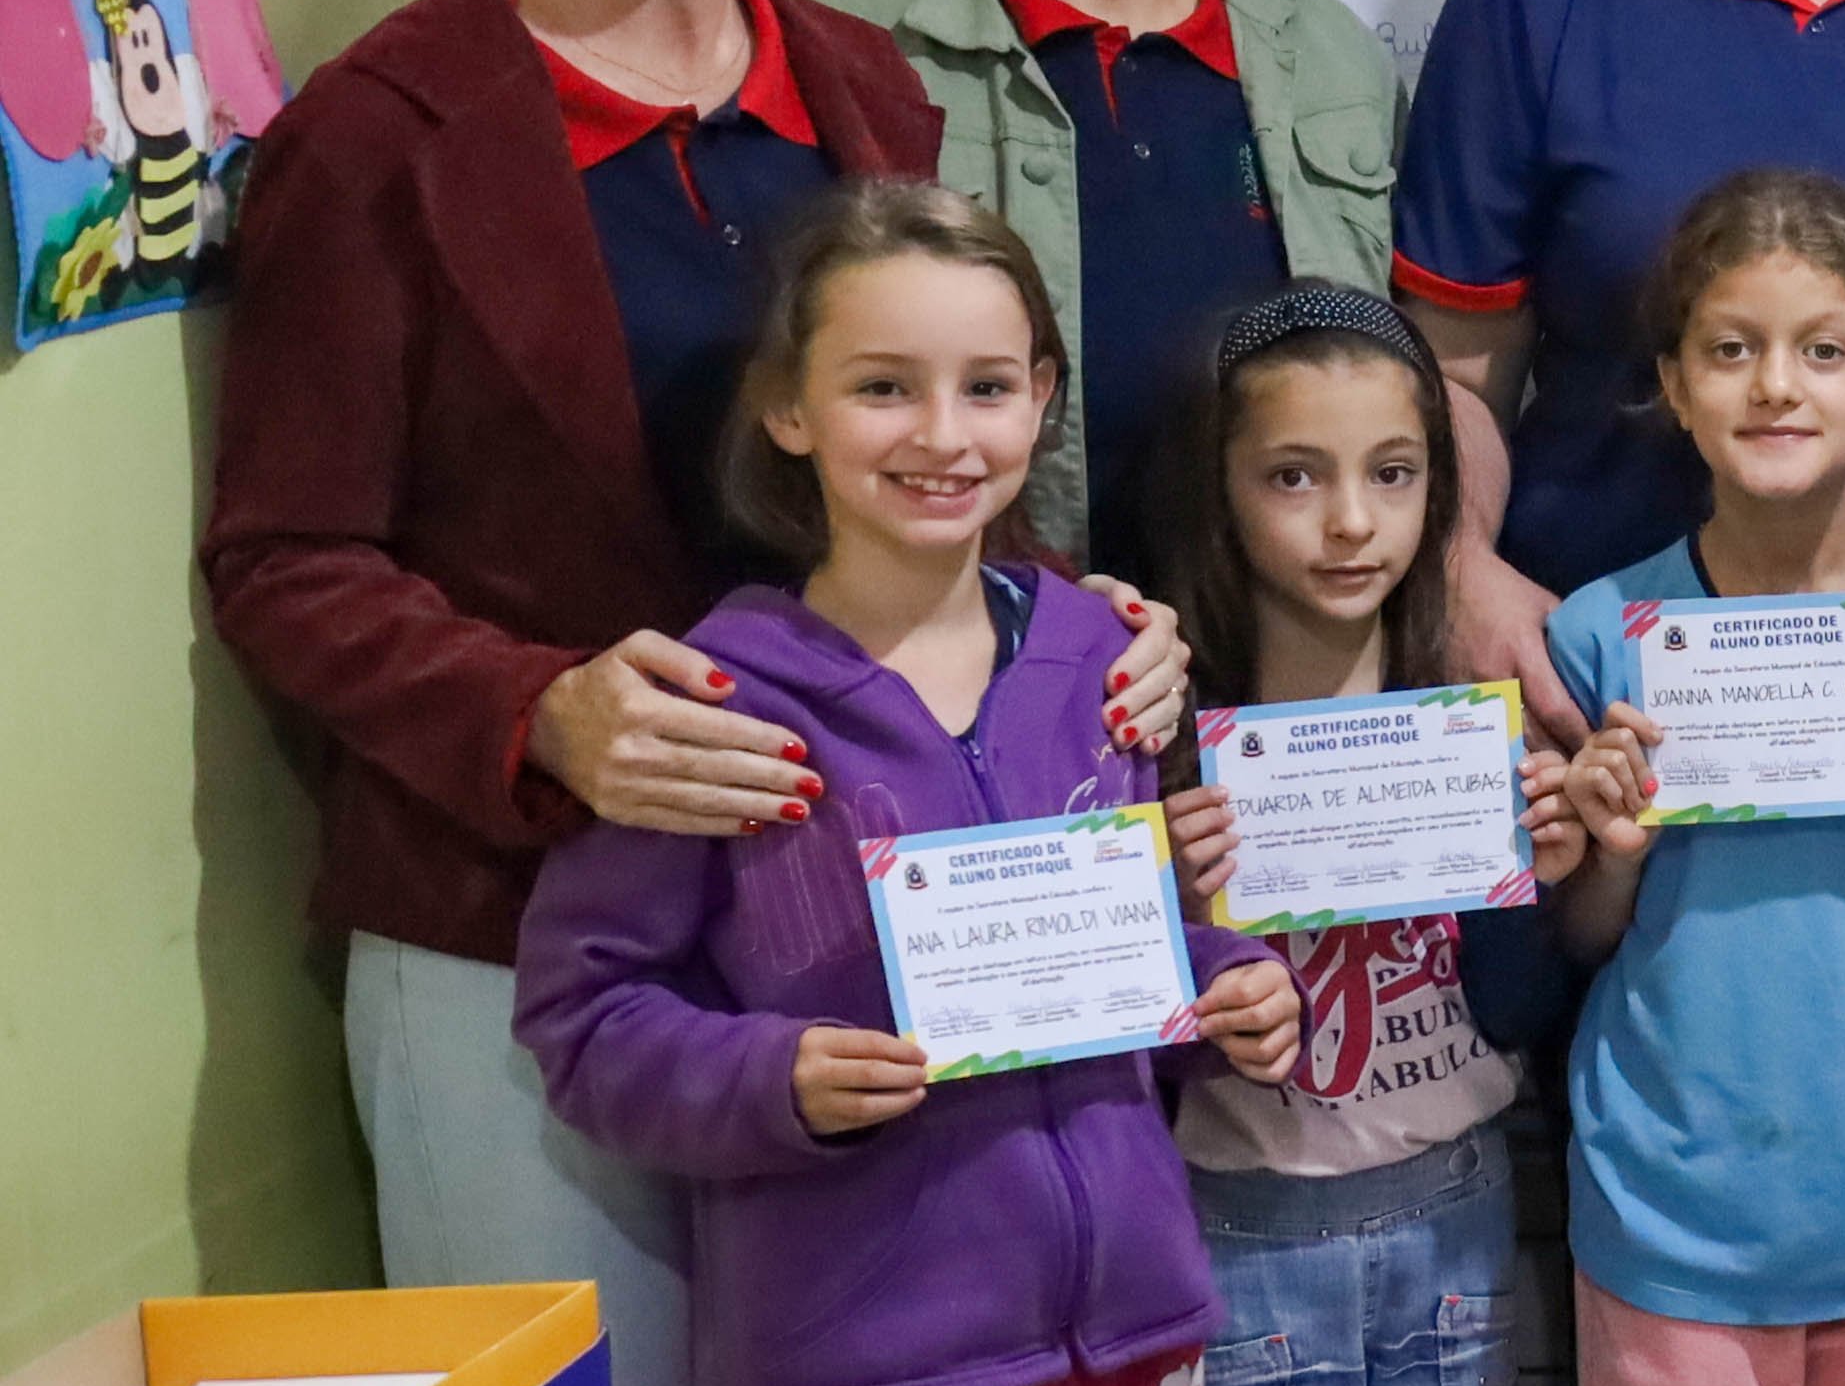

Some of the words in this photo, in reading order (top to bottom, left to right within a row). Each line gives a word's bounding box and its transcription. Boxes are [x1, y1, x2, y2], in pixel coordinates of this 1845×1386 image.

[1713, 616, 1814, 634] CERTIFICADO
[1818, 615, 1838, 628] DE
[1710, 635, 1760, 650] ALUNO
[1765, 630, 1843, 648] DESTAQUE
[1649, 686, 1713, 708] JOANNA
[1722, 681, 1813, 703] MANOELLA
[1290, 717, 1390, 738] CERTIFICADO
[1395, 713, 1415, 727] DE
[1287, 737, 1337, 754] ALUNO
[1342, 729, 1420, 750] DESTAQUE
[1323, 789, 1347, 808] DE
[1357, 778, 1437, 804] ALMEIDA
[1446, 771, 1507, 795] RUBAS
[949, 844, 1046, 869] CERTIFICADO
[1048, 841, 1066, 856] DE
[949, 868, 996, 886] ALUNO
[1000, 857, 1072, 880] DESTAQUE
[906, 932, 946, 957] ANA
[953, 921, 1018, 950] LAURA
[1026, 908, 1099, 944] RIMOLDI
[1108, 900, 1161, 927] VIANA
[1356, 1029, 1490, 1101] ABULO
